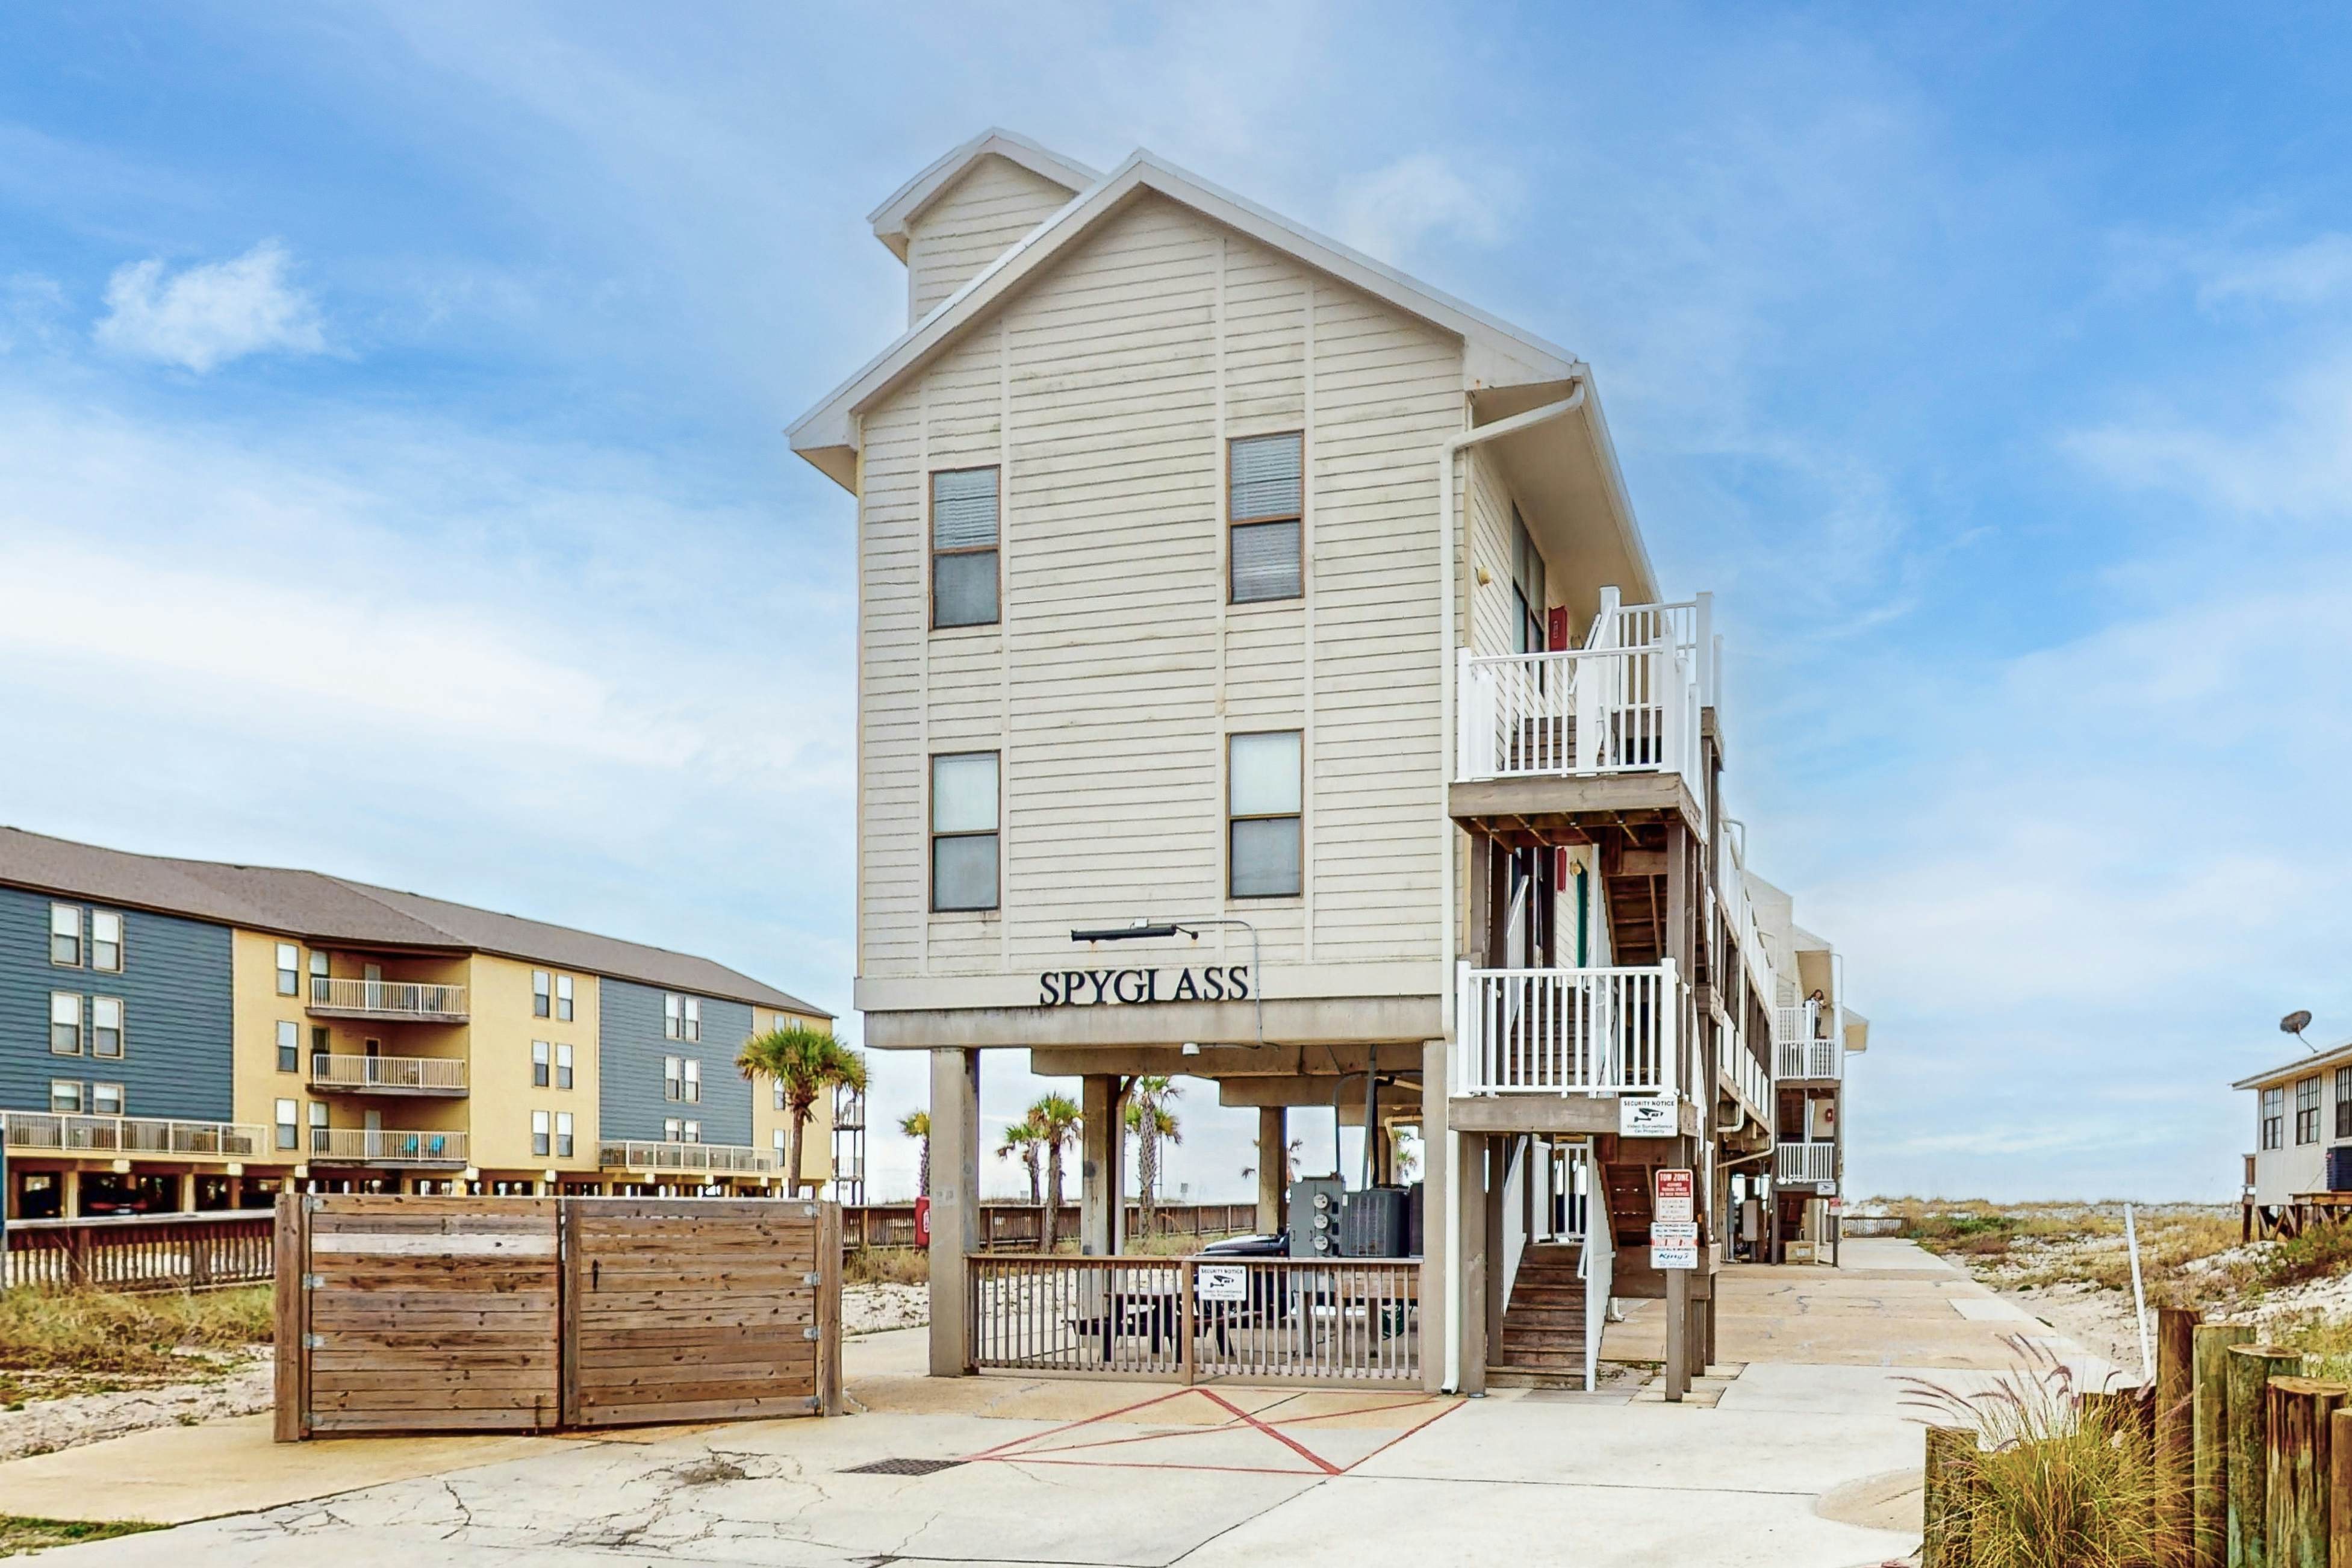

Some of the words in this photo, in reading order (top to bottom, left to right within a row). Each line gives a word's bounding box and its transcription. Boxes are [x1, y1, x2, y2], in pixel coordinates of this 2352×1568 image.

[1040, 966, 1248, 1005] SPYGLASS
[1660, 1173, 1672, 1181] TOW
[1673, 1173, 1690, 1181] ZONE
